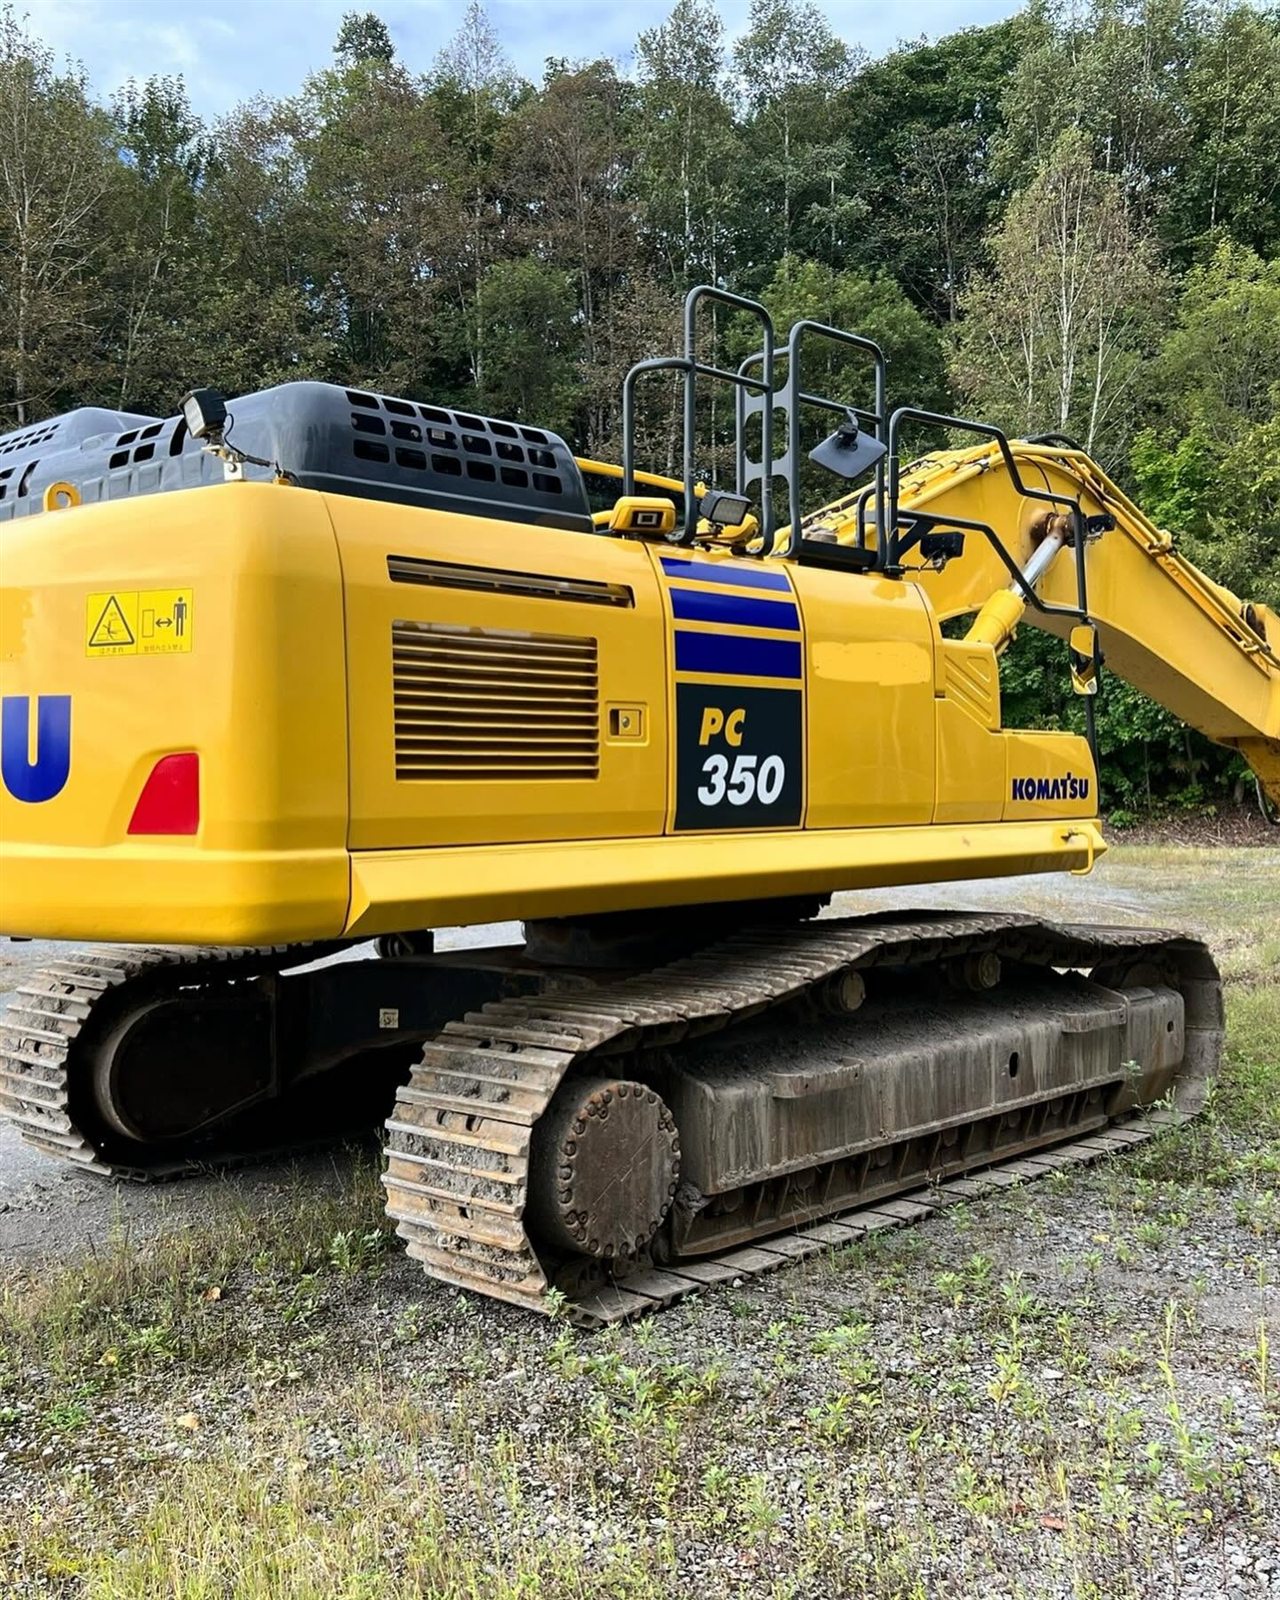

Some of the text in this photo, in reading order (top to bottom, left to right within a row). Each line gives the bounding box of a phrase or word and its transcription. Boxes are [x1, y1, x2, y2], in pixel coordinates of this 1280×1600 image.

[1, 695, 71, 803] U
[699, 707, 746, 747] PC
[697, 754, 786, 806] 350
[1012, 772, 1089, 801] KOMATSU
